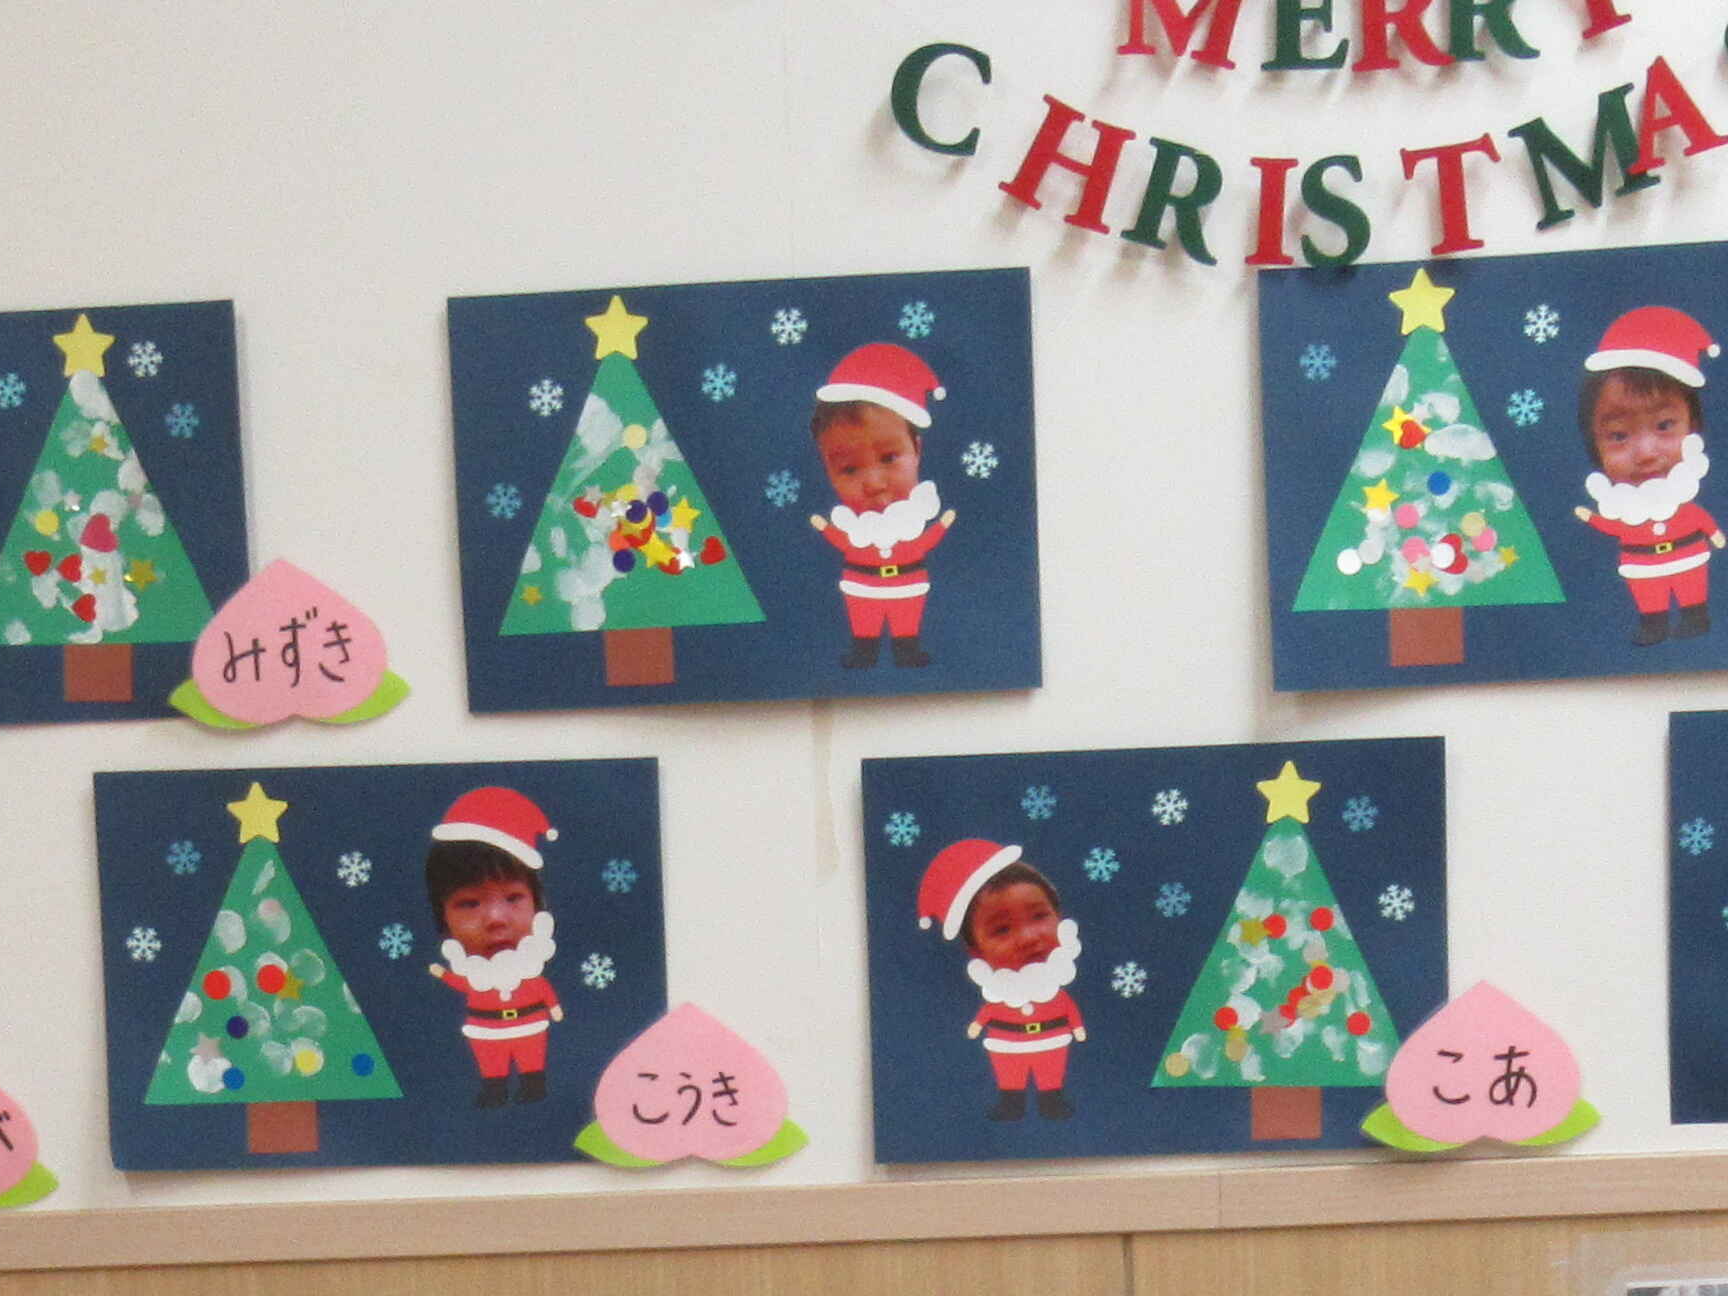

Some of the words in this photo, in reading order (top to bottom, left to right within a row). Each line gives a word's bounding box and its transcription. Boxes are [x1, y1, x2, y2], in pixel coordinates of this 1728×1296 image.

[223, 607, 352, 688] みずき
[632, 1072, 739, 1126] こうき
[1433, 1046, 1537, 1108] こあ
